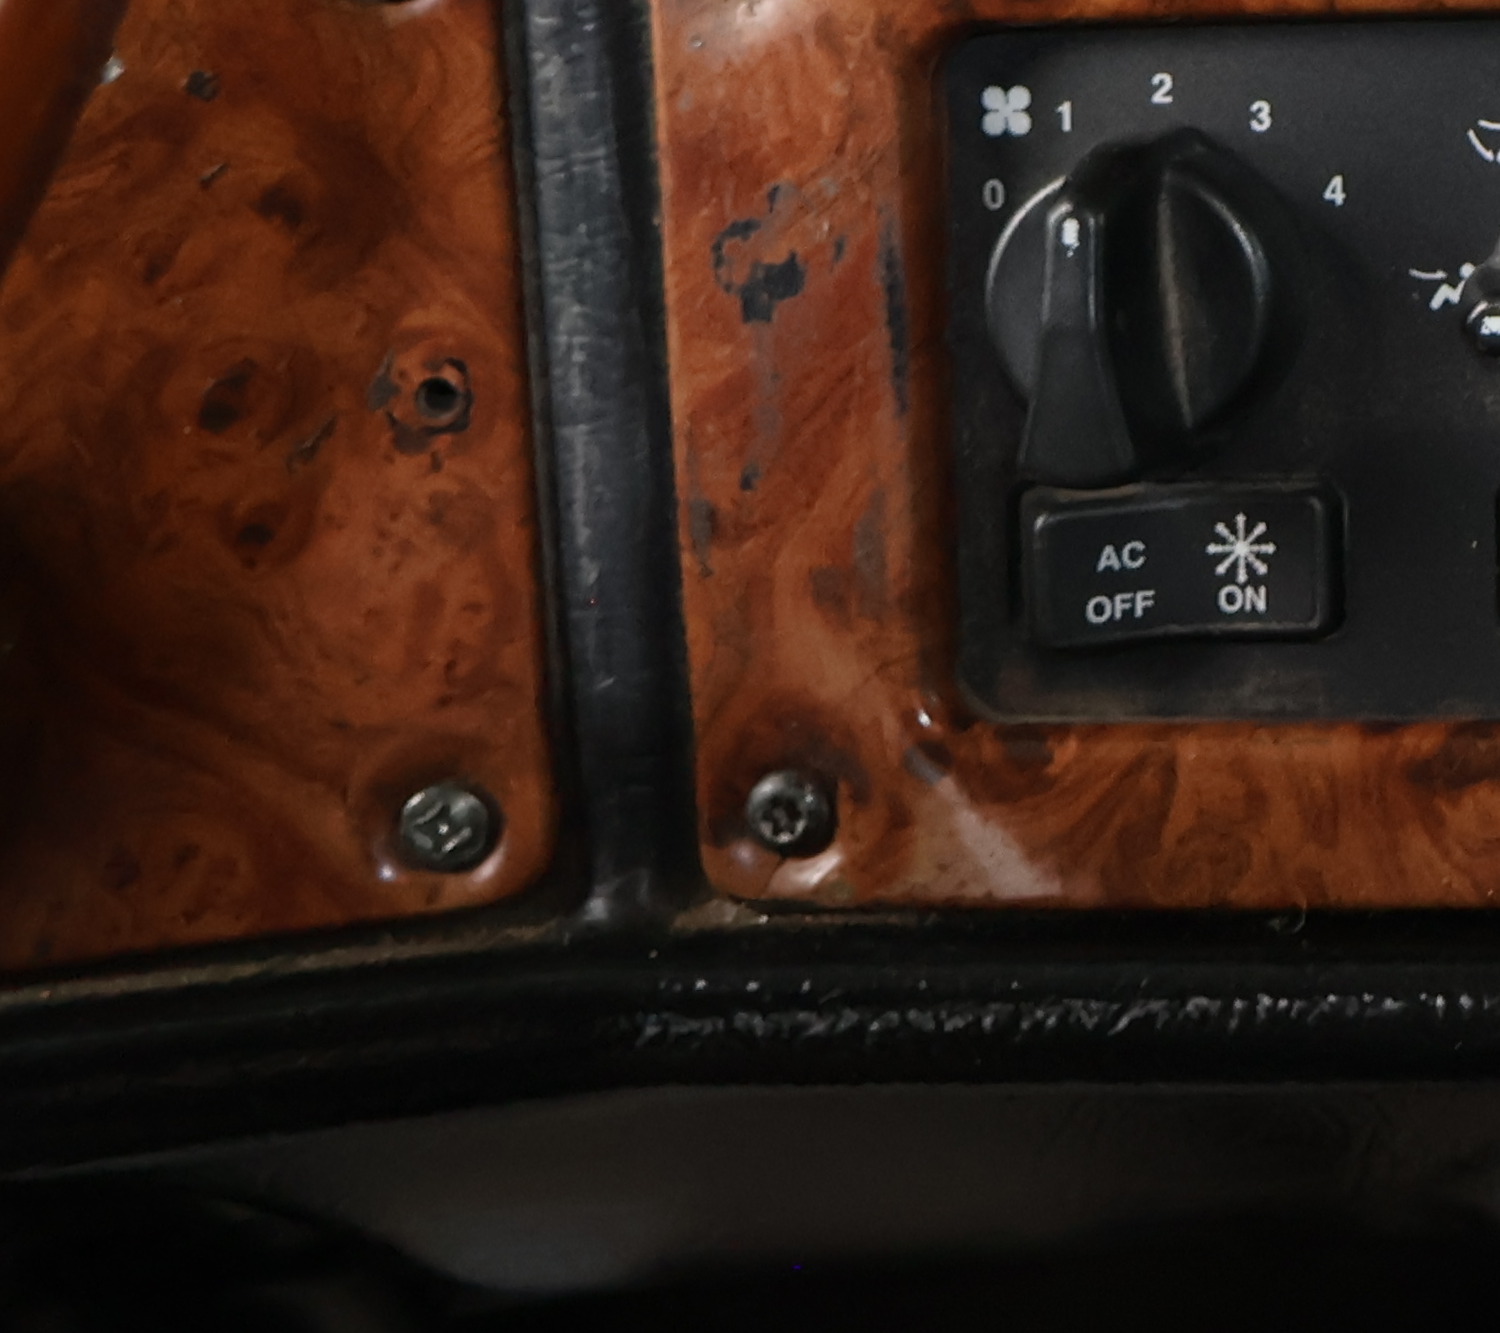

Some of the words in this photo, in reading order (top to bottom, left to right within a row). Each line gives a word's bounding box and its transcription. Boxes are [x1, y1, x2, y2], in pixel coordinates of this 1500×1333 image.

[1151, 74, 1173, 104] 2
[1056, 101, 1073, 131] 1
[1251, 101, 1272, 131] 3
[983, 180, 1004, 211] 0
[1323, 176, 1346, 206] 4
[1098, 541, 1146, 571] AC
[1086, 590, 1156, 623] OFF
[1218, 585, 1267, 613] ON
